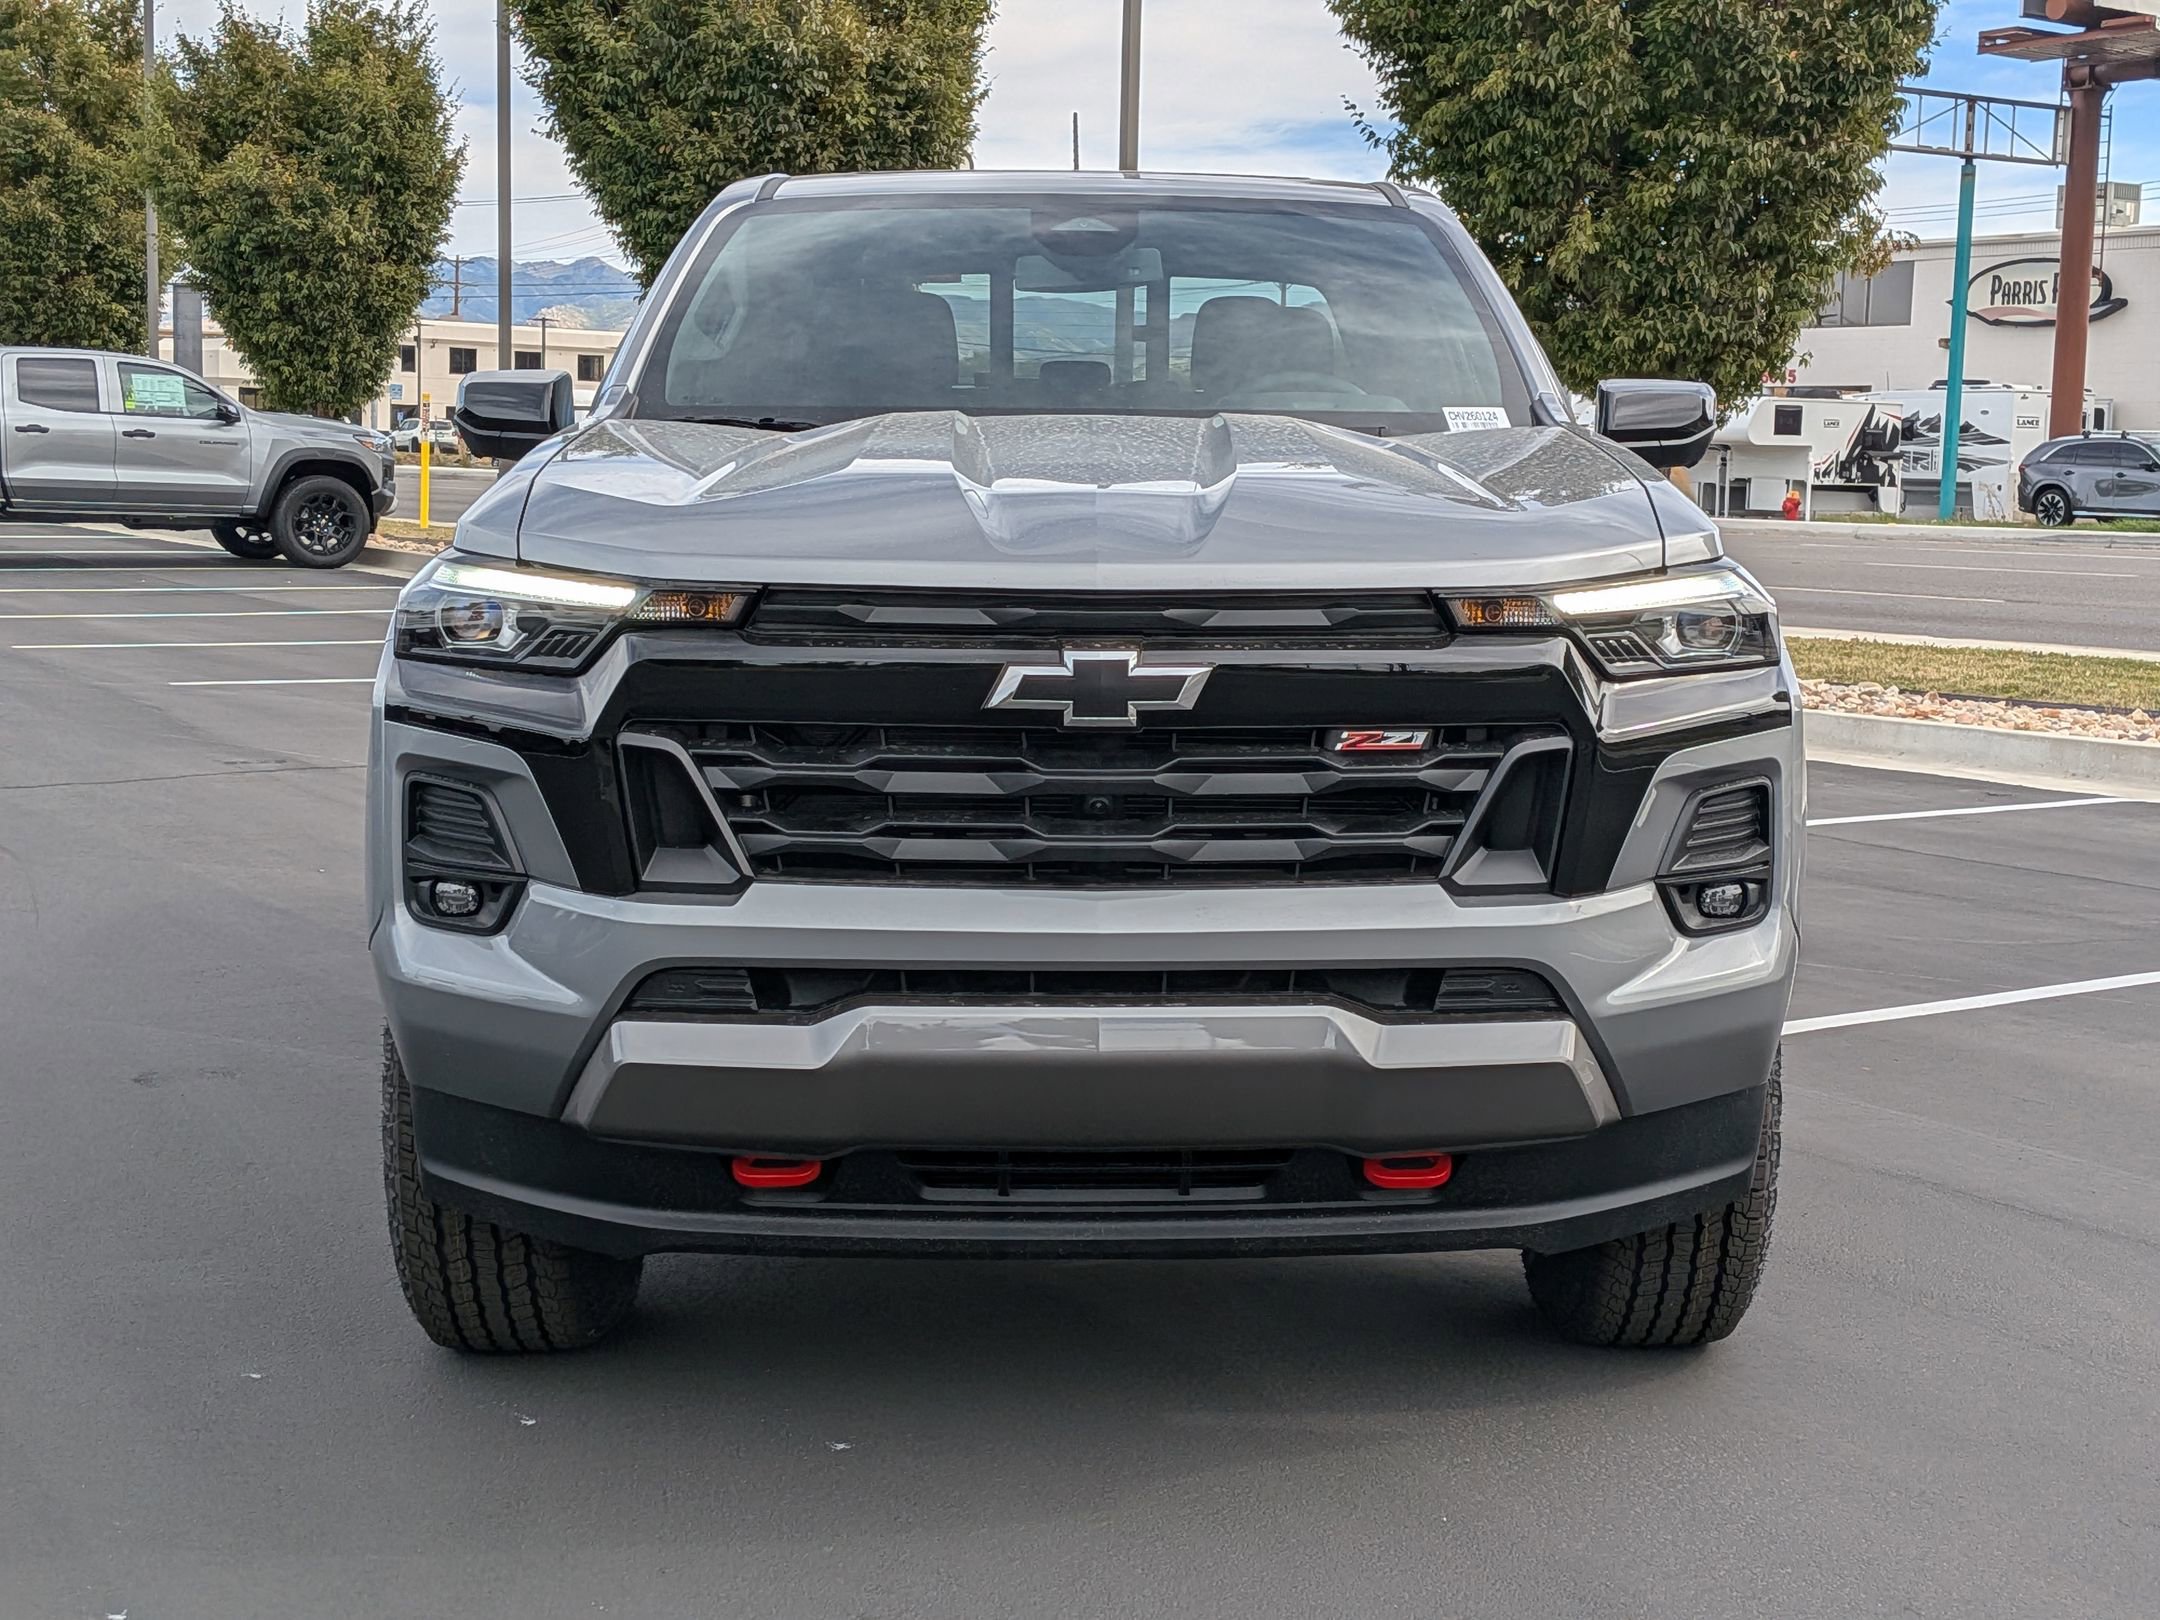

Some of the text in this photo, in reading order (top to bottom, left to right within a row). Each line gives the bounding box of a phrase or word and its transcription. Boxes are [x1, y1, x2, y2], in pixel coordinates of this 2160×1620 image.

[1990, 274, 2049, 306] PARRIS
[1448, 411, 1498, 422] CHV260124
[1335, 731, 1429, 751] Z71
